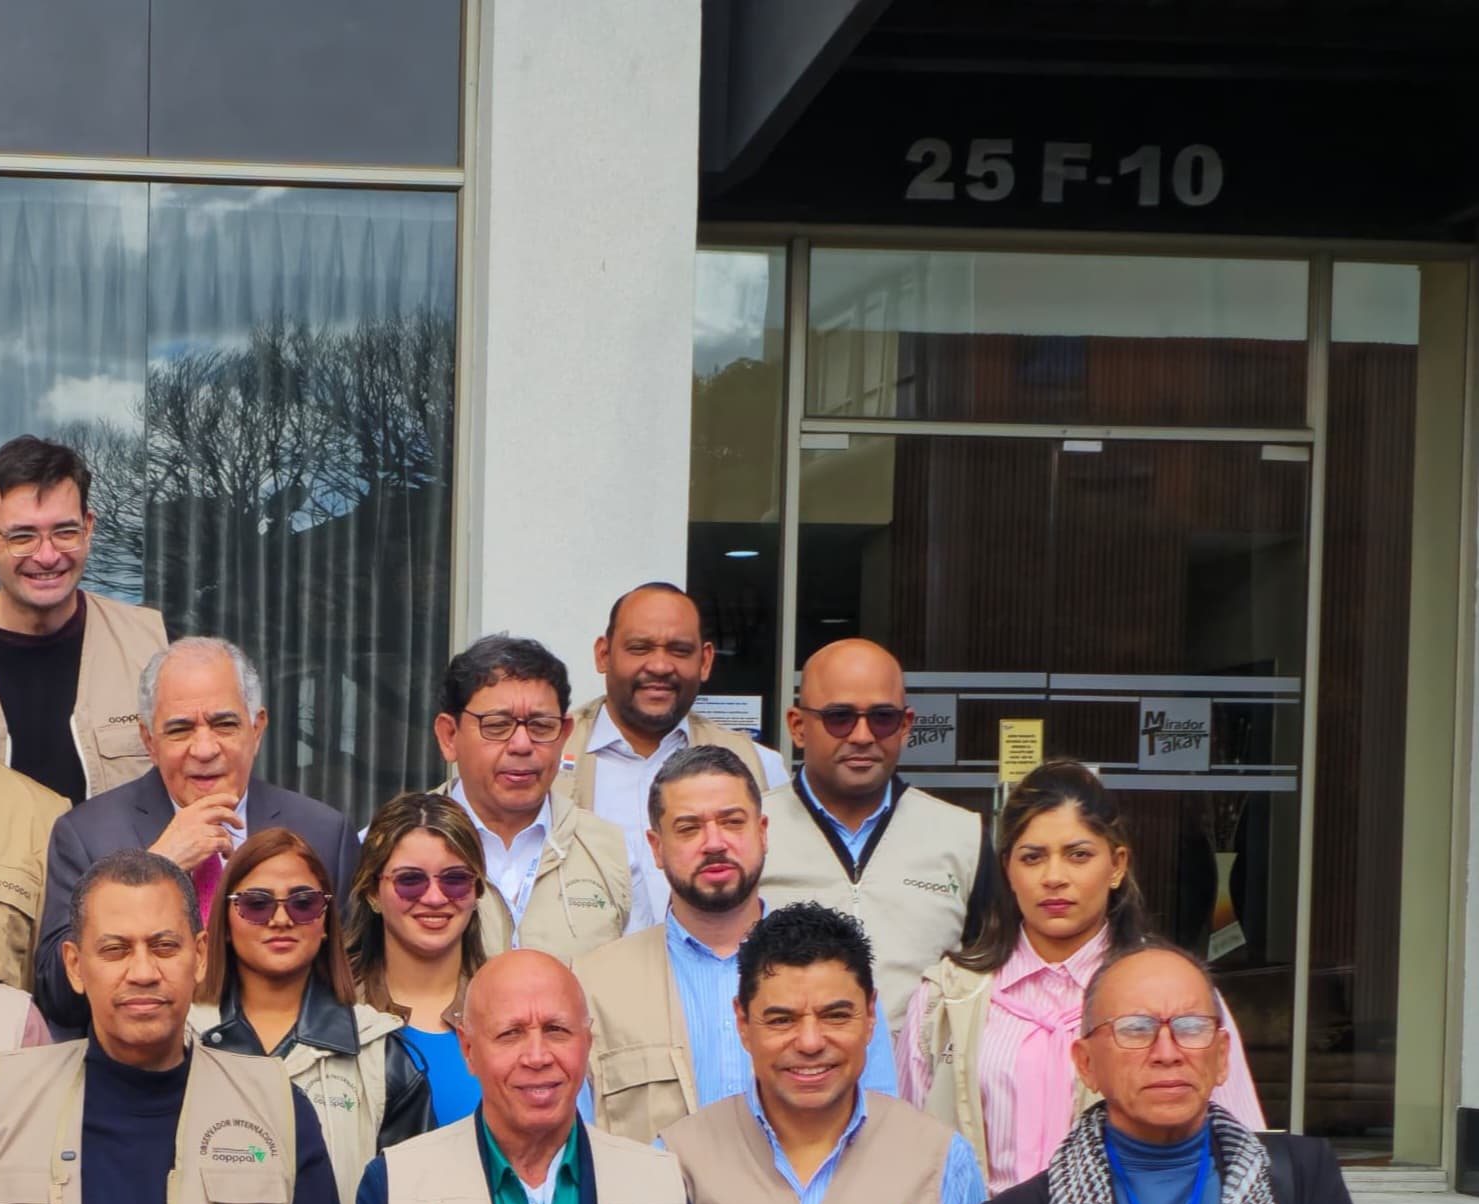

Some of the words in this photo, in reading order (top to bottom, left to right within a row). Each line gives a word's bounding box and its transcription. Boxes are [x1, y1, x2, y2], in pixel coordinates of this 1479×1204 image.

[905, 137, 1015, 202] 25
[1041, 141, 1224, 206] F-10
[1144, 710, 1205, 731] Mirador
[212, 1153, 256, 1164] copppal
